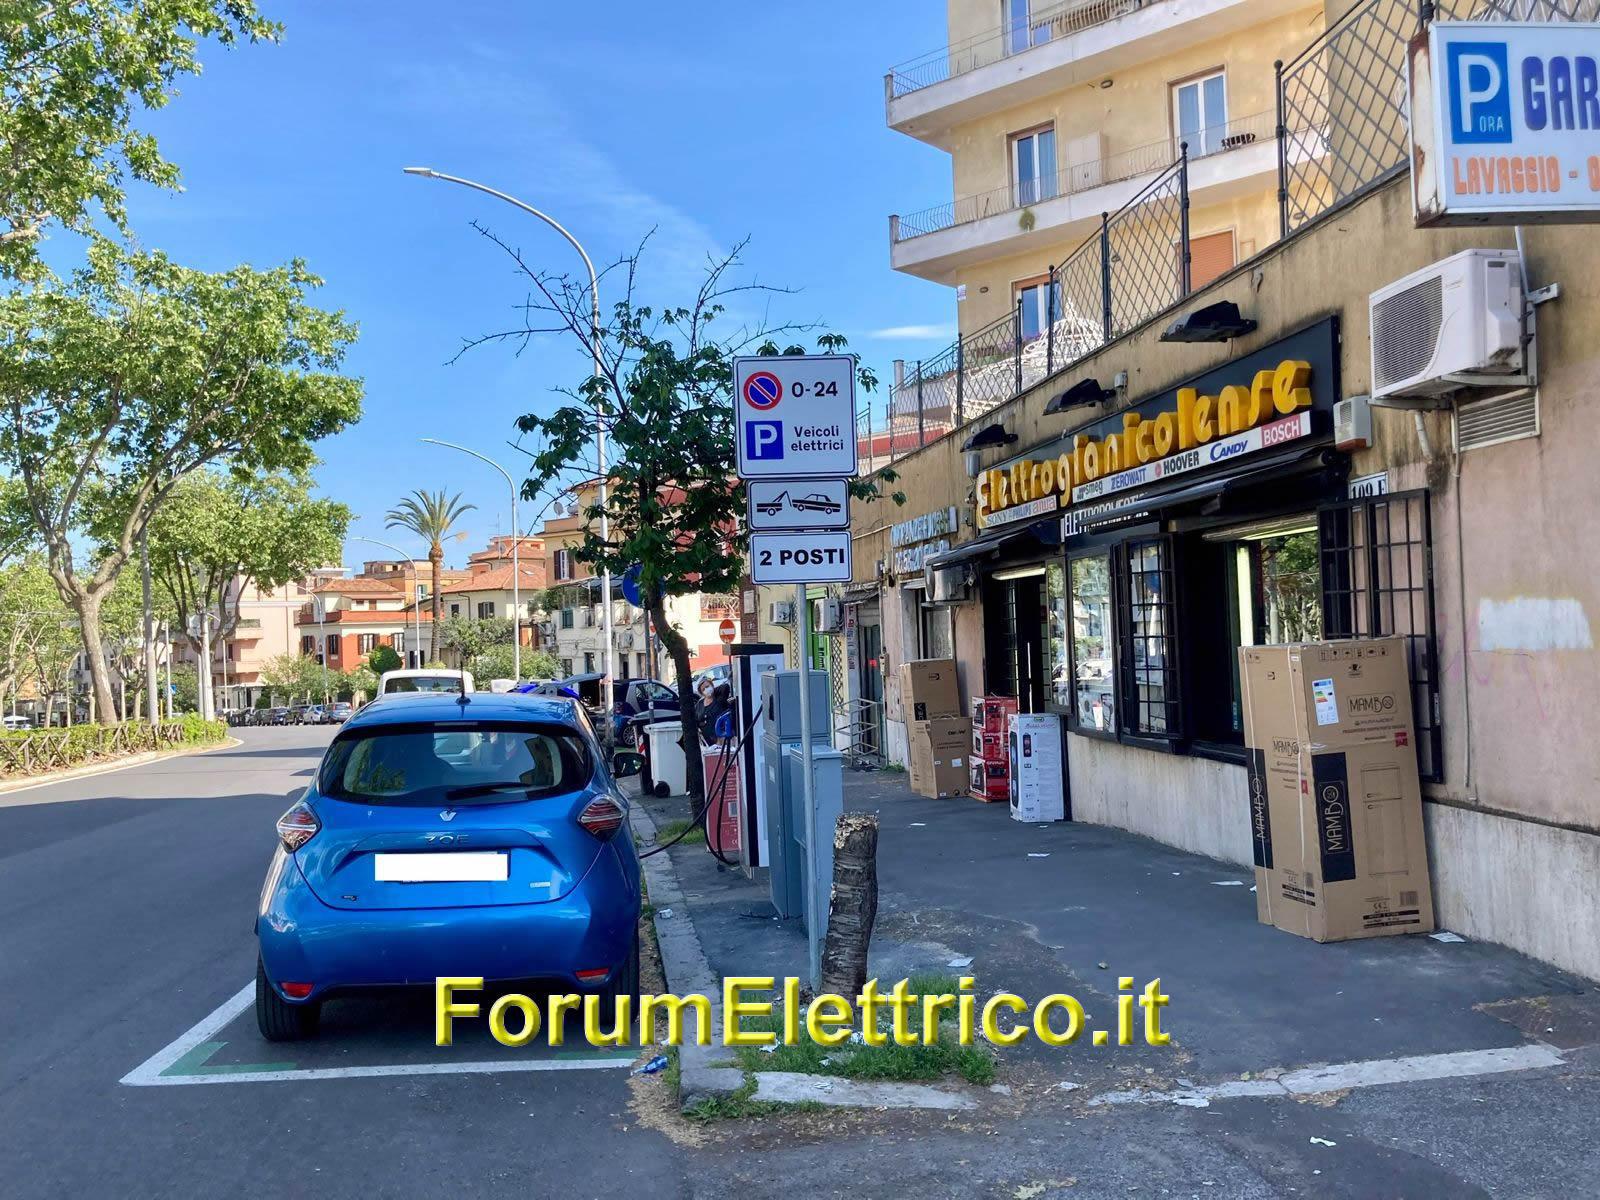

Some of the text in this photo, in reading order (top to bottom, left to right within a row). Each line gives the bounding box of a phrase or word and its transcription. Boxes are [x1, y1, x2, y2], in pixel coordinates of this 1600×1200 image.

[1458, 54, 1502, 133] P
[1479, 116, 1505, 133] ORA
[1452, 155, 1562, 195] LAVAGGIO
[794, 425, 840, 438] Veicoli
[790, 439, 845, 451] elettrici
[1086, 480, 1103, 495] smeg
[1111, 468, 1146, 490] ZEROWATT
[1163, 450, 1200, 475] HOOVER
[1263, 419, 1300, 445] BOSCH
[987, 510, 1008, 526] SONY
[759, 548, 845, 566] 2 POSTI
[1350, 695, 1394, 713] MAMBO
[1253, 777, 1266, 839] MAMBO
[1322, 785, 1345, 851] MAMBO
